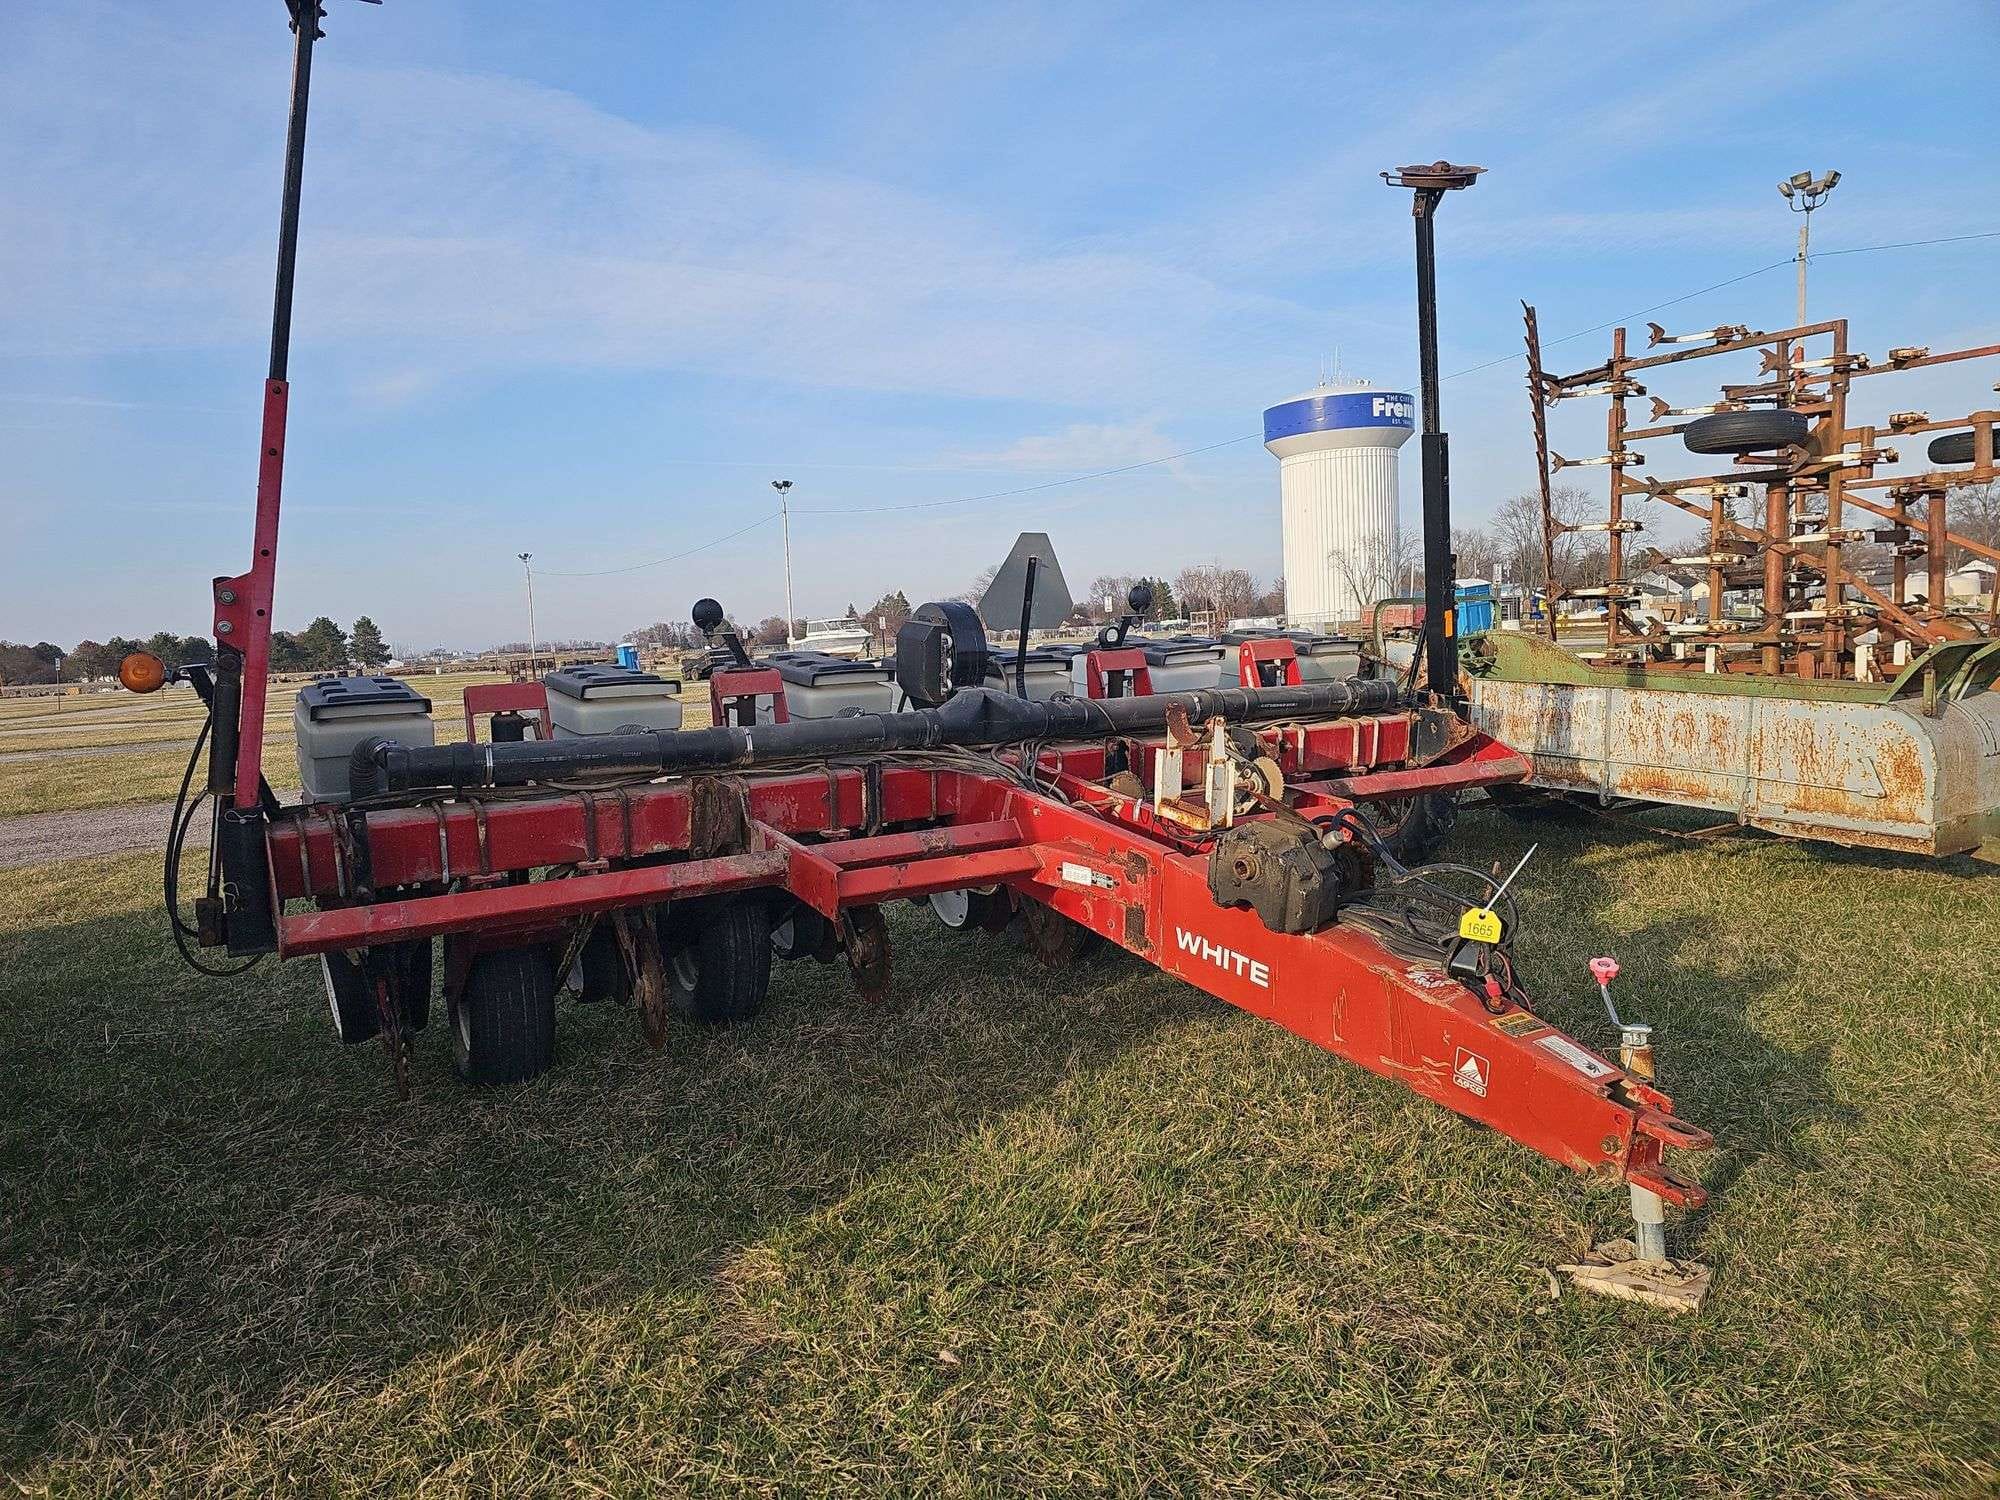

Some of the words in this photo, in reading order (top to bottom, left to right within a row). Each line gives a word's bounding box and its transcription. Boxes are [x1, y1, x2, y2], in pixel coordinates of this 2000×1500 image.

[1468, 922, 1494, 937] 1665
[1175, 926, 1270, 989] WHITE
[1456, 1077, 1484, 1095] AGCO
